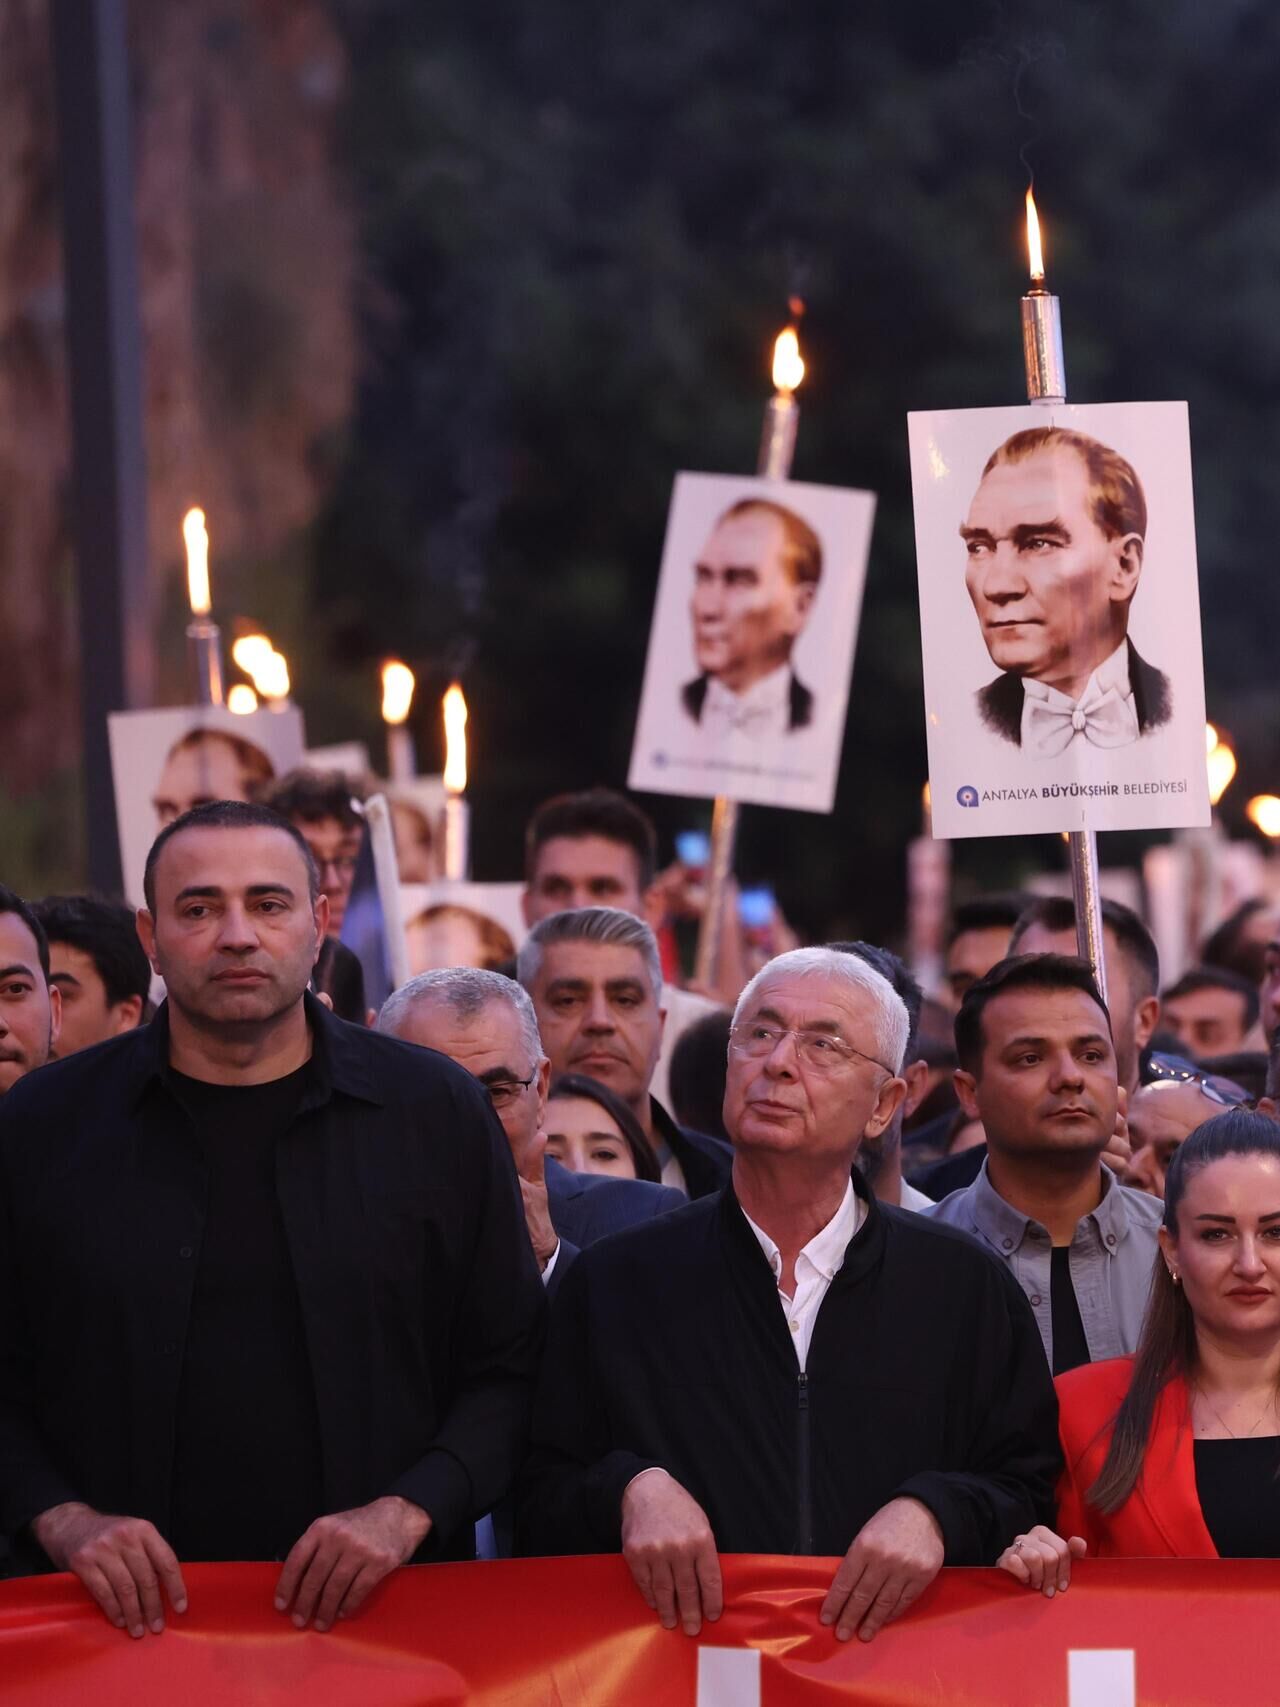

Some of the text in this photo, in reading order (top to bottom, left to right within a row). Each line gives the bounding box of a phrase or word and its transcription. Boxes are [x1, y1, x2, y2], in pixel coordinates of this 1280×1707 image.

[982, 779, 1188, 801] ANTALYA BÜYÜKŞEHİR BELEDİYESİ
